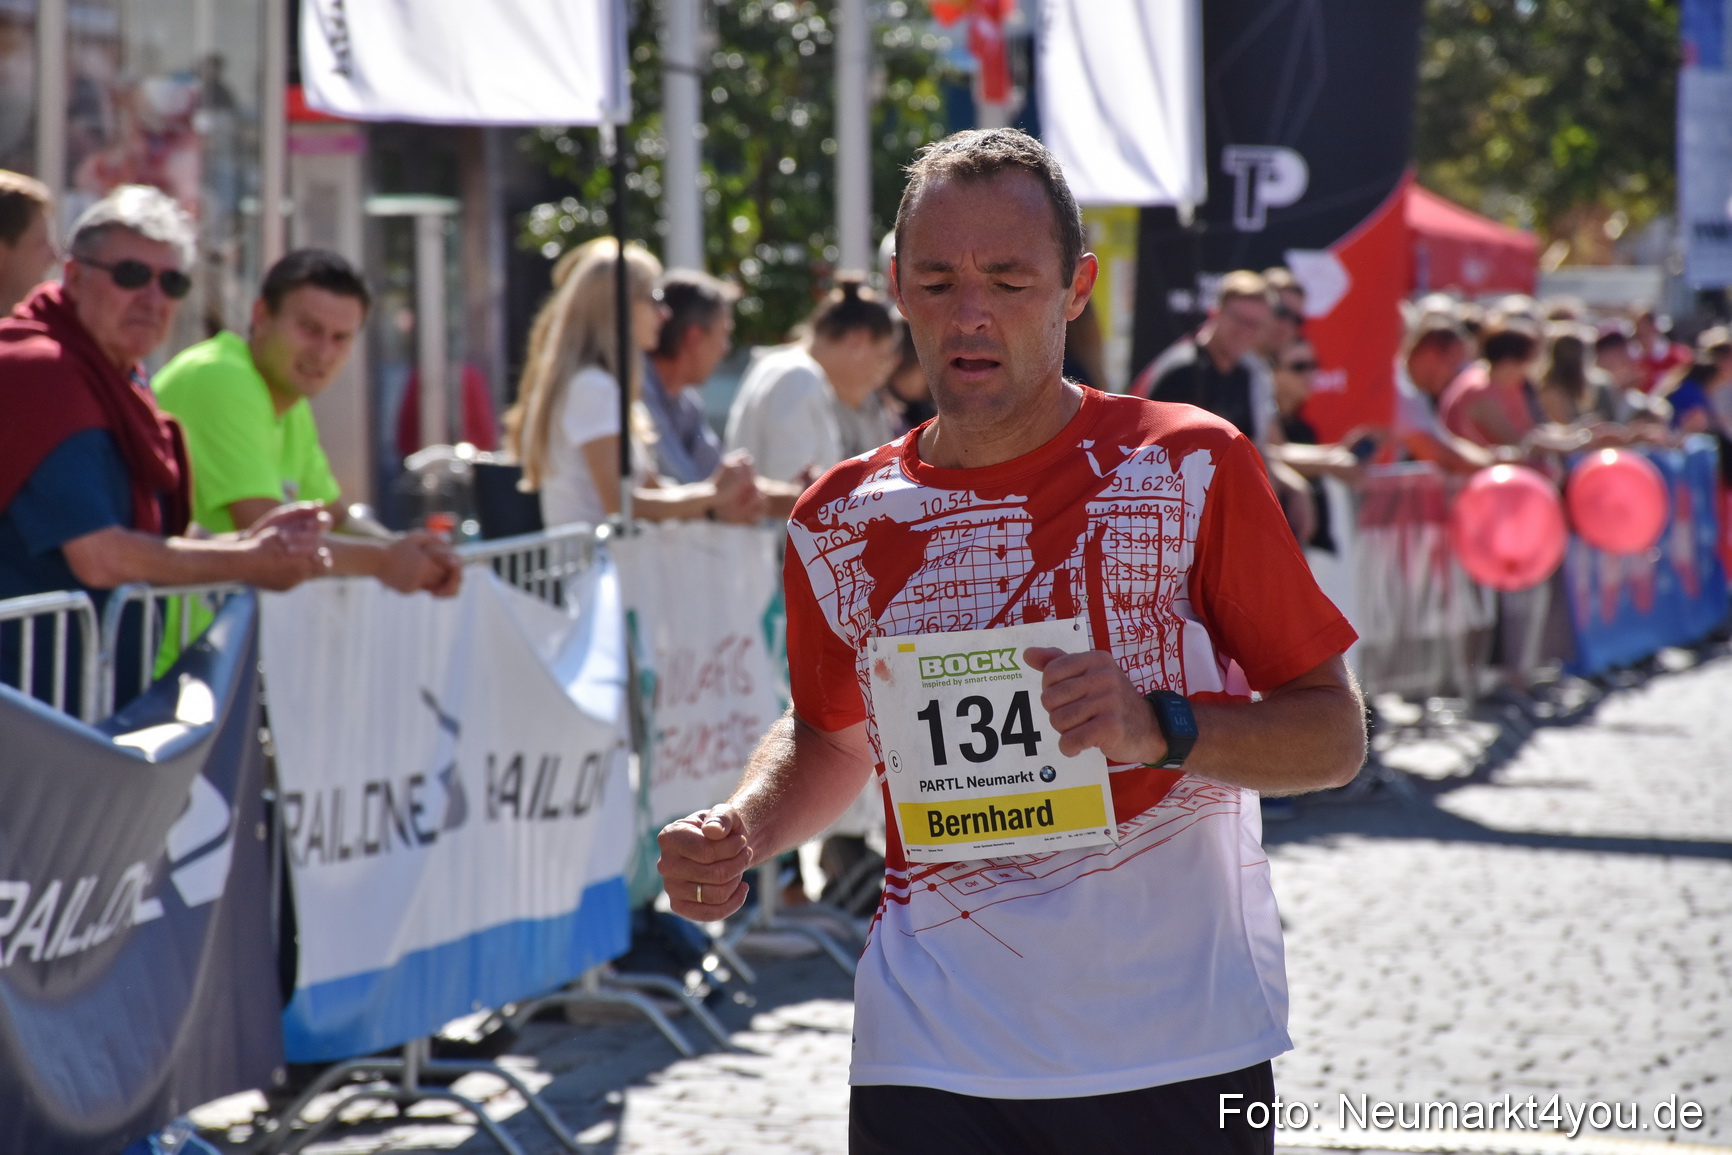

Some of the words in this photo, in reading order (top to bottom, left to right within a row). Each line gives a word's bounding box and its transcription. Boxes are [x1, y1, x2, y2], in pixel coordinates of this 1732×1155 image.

[1111, 474, 1182, 493] 91.62%
[919, 489, 973, 519] 10.54
[912, 579, 974, 605] 52.01
[919, 648, 1020, 679] BOCK
[922, 679, 951, 689] inspired
[953, 678, 963, 687] by
[964, 675, 988, 684] smart
[988, 672, 1023, 683] concepts
[917, 690, 1042, 766] 134
[919, 777, 964, 793] PARTL
[966, 771, 1035, 789] Neumarkt
[927, 799, 1055, 838] Bernhard
